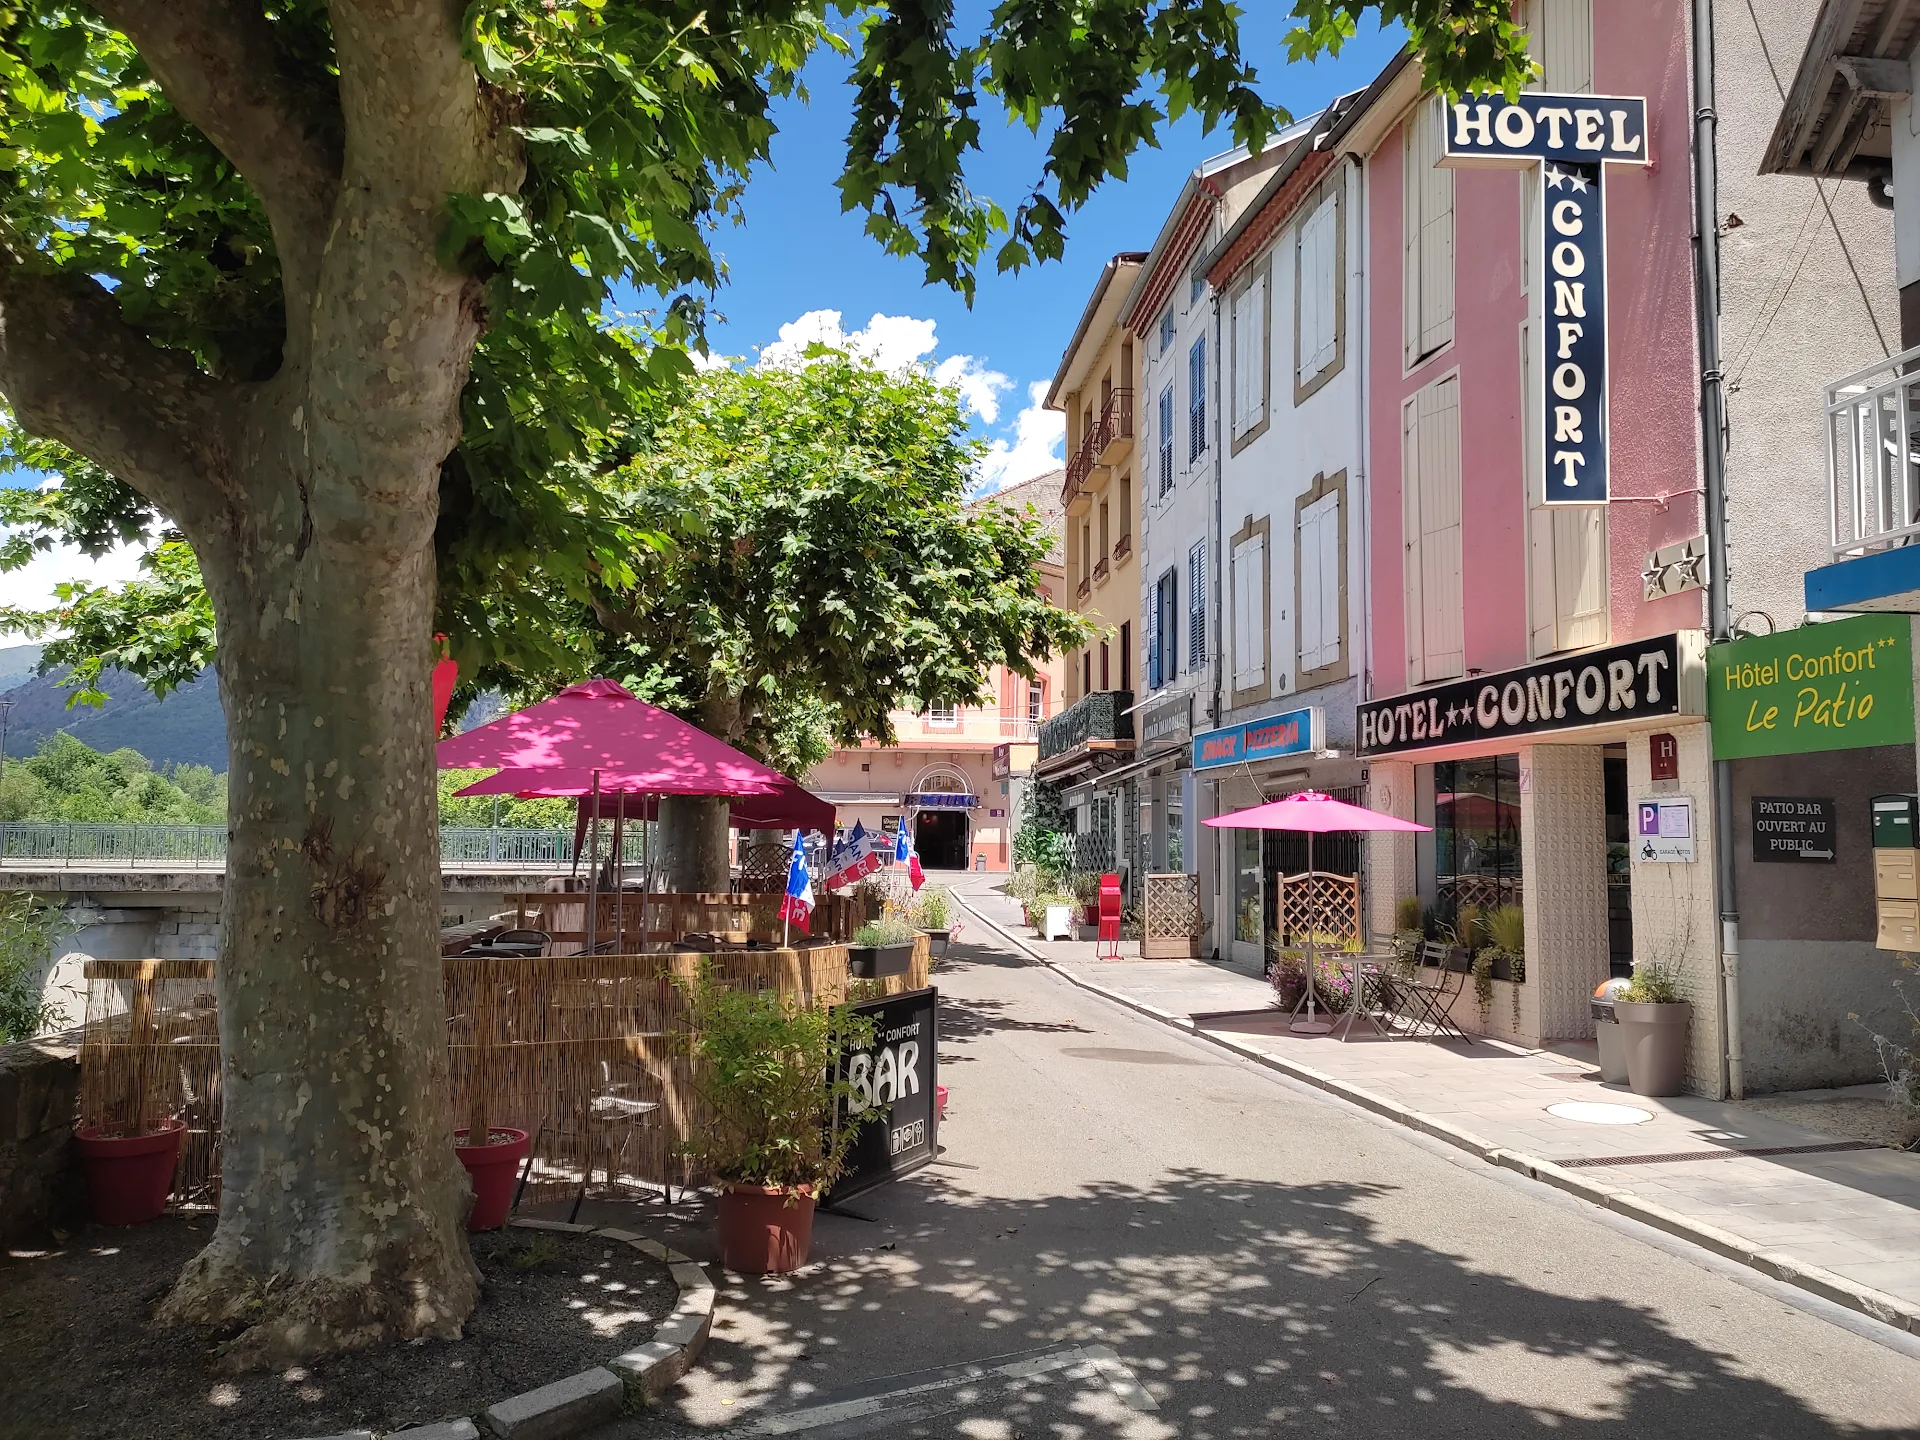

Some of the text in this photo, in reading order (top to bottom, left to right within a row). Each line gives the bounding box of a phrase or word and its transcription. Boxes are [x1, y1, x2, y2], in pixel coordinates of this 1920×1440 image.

[1454, 104, 1641, 153] HOTEL
[1552, 200, 1587, 488] CONFORT
[1726, 642, 1876, 691] Hôtel Confort
[1361, 650, 1669, 748] HOTEL CONFORT
[1746, 680, 1874, 732] Le Patio
[1202, 721, 1299, 761] SNACK PIZZERIA
[1660, 741, 1674, 757] H
[1642, 807, 1655, 831] P
[1757, 820, 1826, 833] OUVERT AU
[1760, 802, 1822, 815] PATIO BAR
[850, 834, 870, 877] RANCE
[1770, 839, 1814, 851] PUBLIC
[886, 1022, 920, 1042] CONFORT
[847, 1041, 920, 1113] BAR
